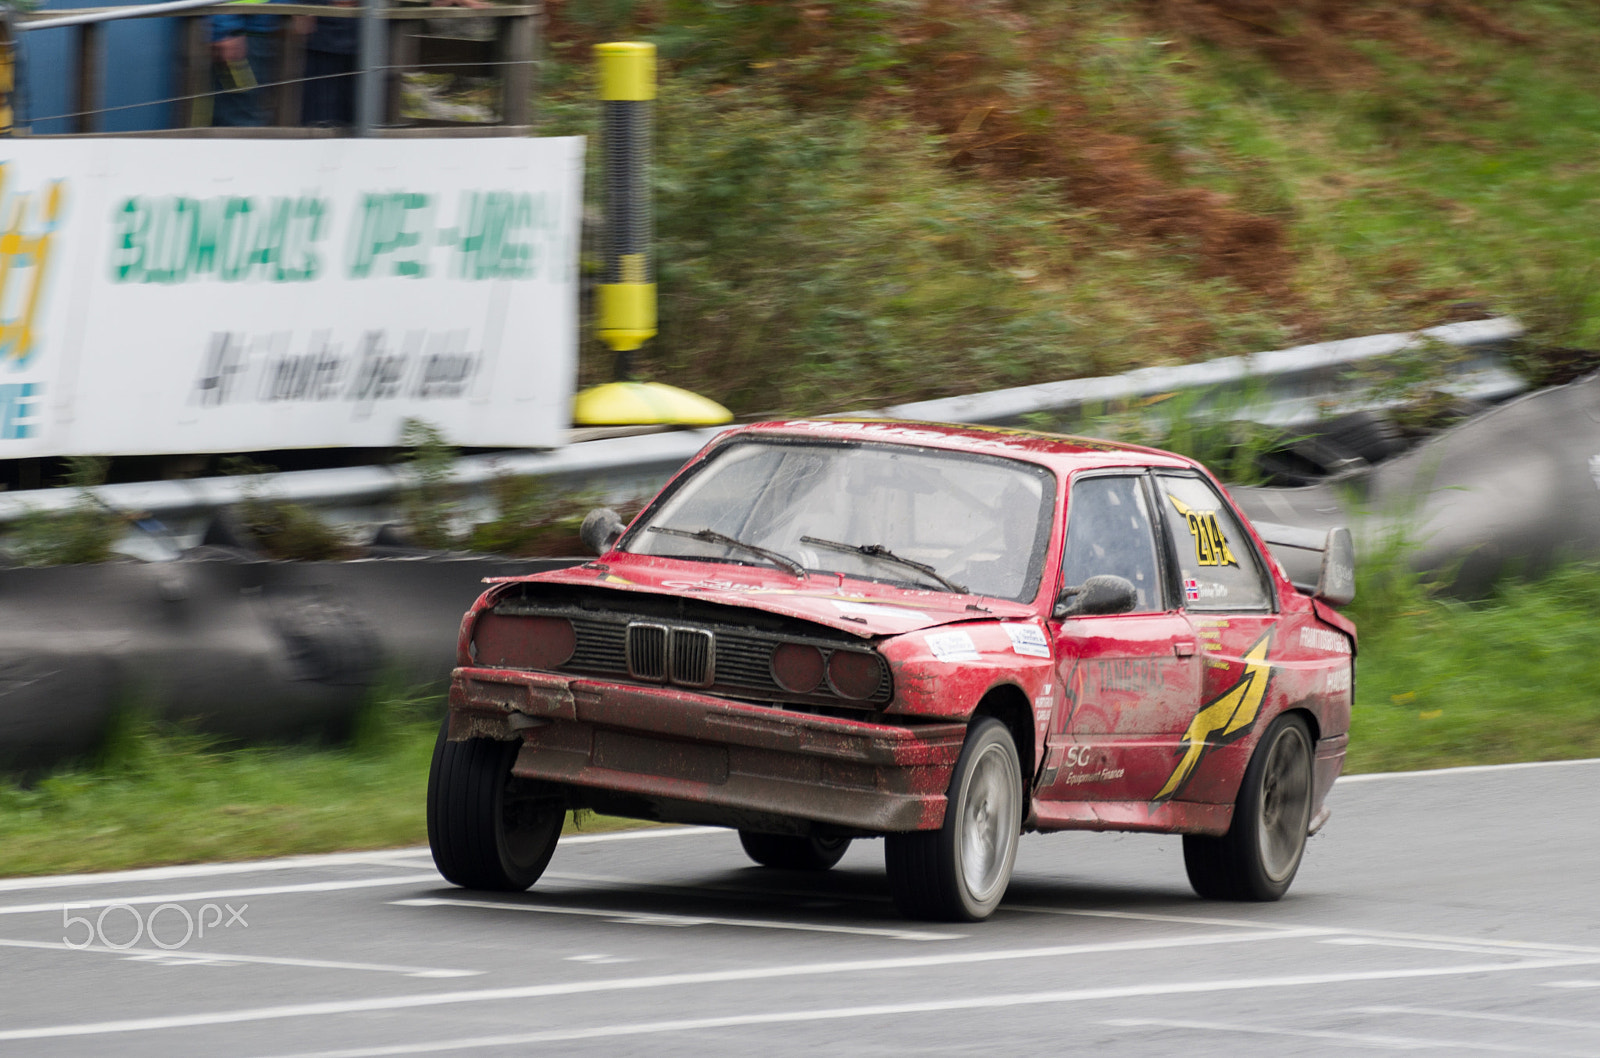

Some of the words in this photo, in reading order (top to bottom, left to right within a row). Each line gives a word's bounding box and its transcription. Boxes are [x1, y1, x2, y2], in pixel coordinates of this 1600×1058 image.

[1185, 510, 1229, 566] 214
[1065, 745, 1091, 767] SG
[1065, 770, 1101, 786] Equipment
[1101, 767, 1125, 780] Finance
